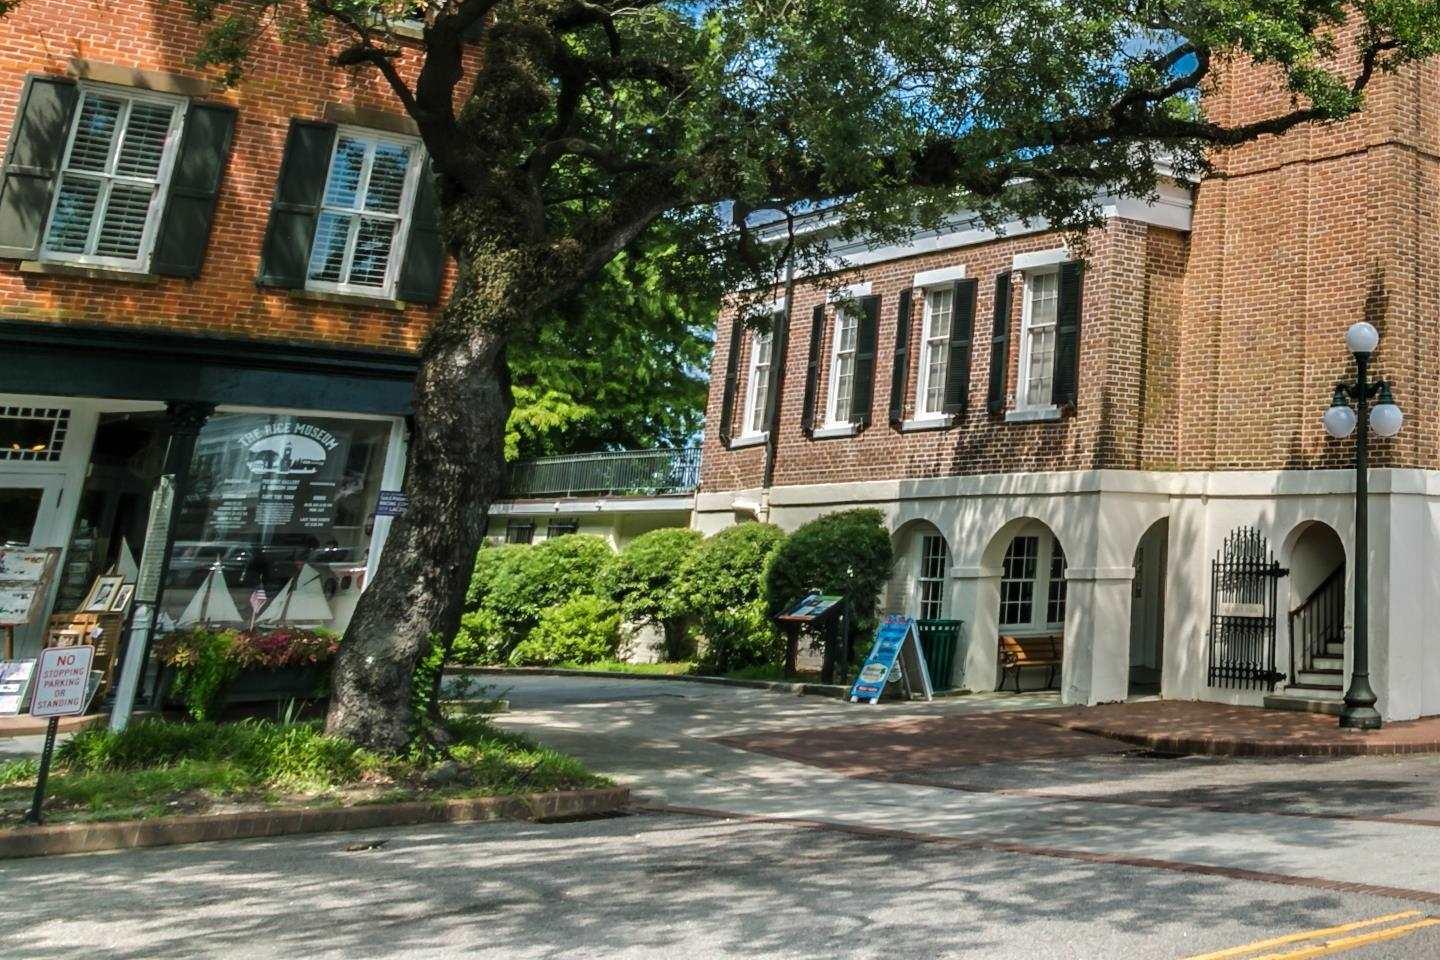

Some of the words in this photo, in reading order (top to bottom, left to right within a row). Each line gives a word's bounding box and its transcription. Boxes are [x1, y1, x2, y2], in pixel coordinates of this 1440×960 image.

[238, 428, 262, 447] THE
[265, 422, 291, 436] RICE
[294, 423, 339, 450] MUSEUM
[57, 655, 75, 666] NO
[44, 667, 84, 678] STOPPING
[44, 678, 80, 688] PARKING
[55, 689, 66, 697] OR
[38, 699, 79, 709] STANDING
